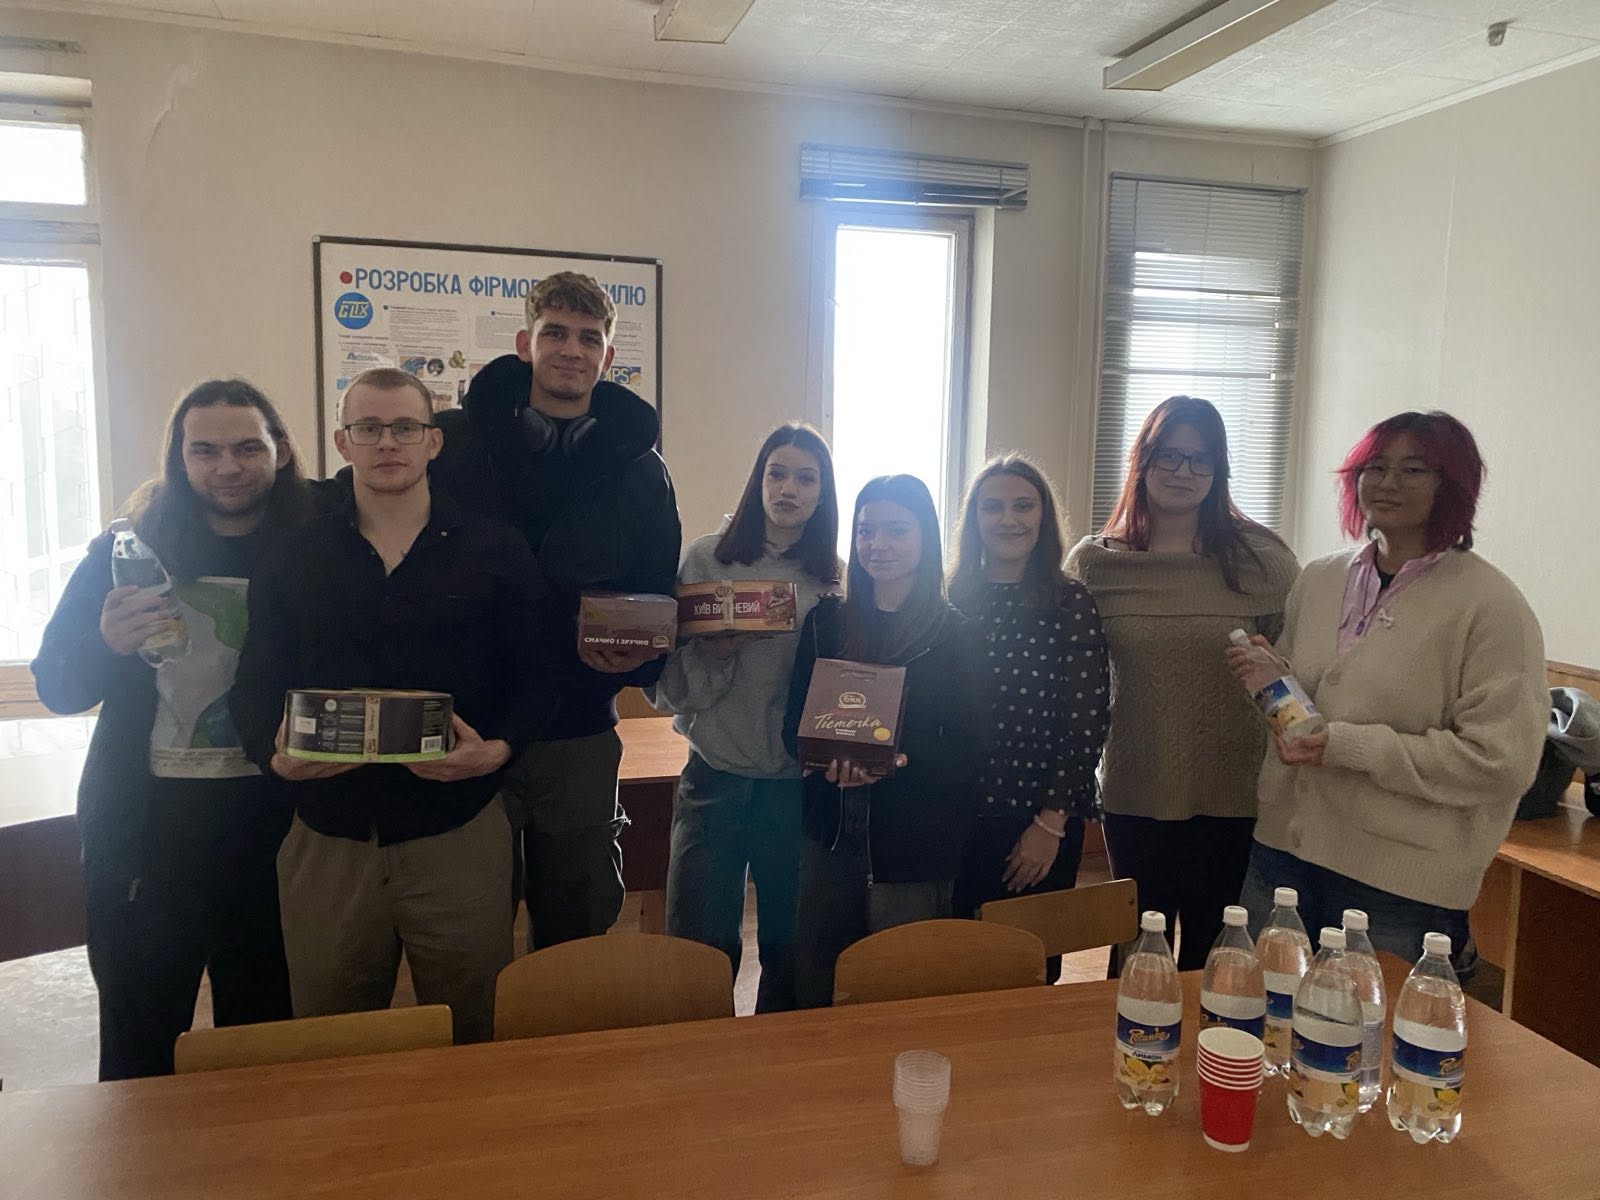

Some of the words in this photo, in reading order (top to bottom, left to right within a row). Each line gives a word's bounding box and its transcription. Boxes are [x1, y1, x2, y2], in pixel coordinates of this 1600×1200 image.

[355, 268, 462, 295] РОЗРОБКА
[712, 600, 761, 614] ВИНЕВИЙ
[584, 637, 615, 645] СМАЧНО
